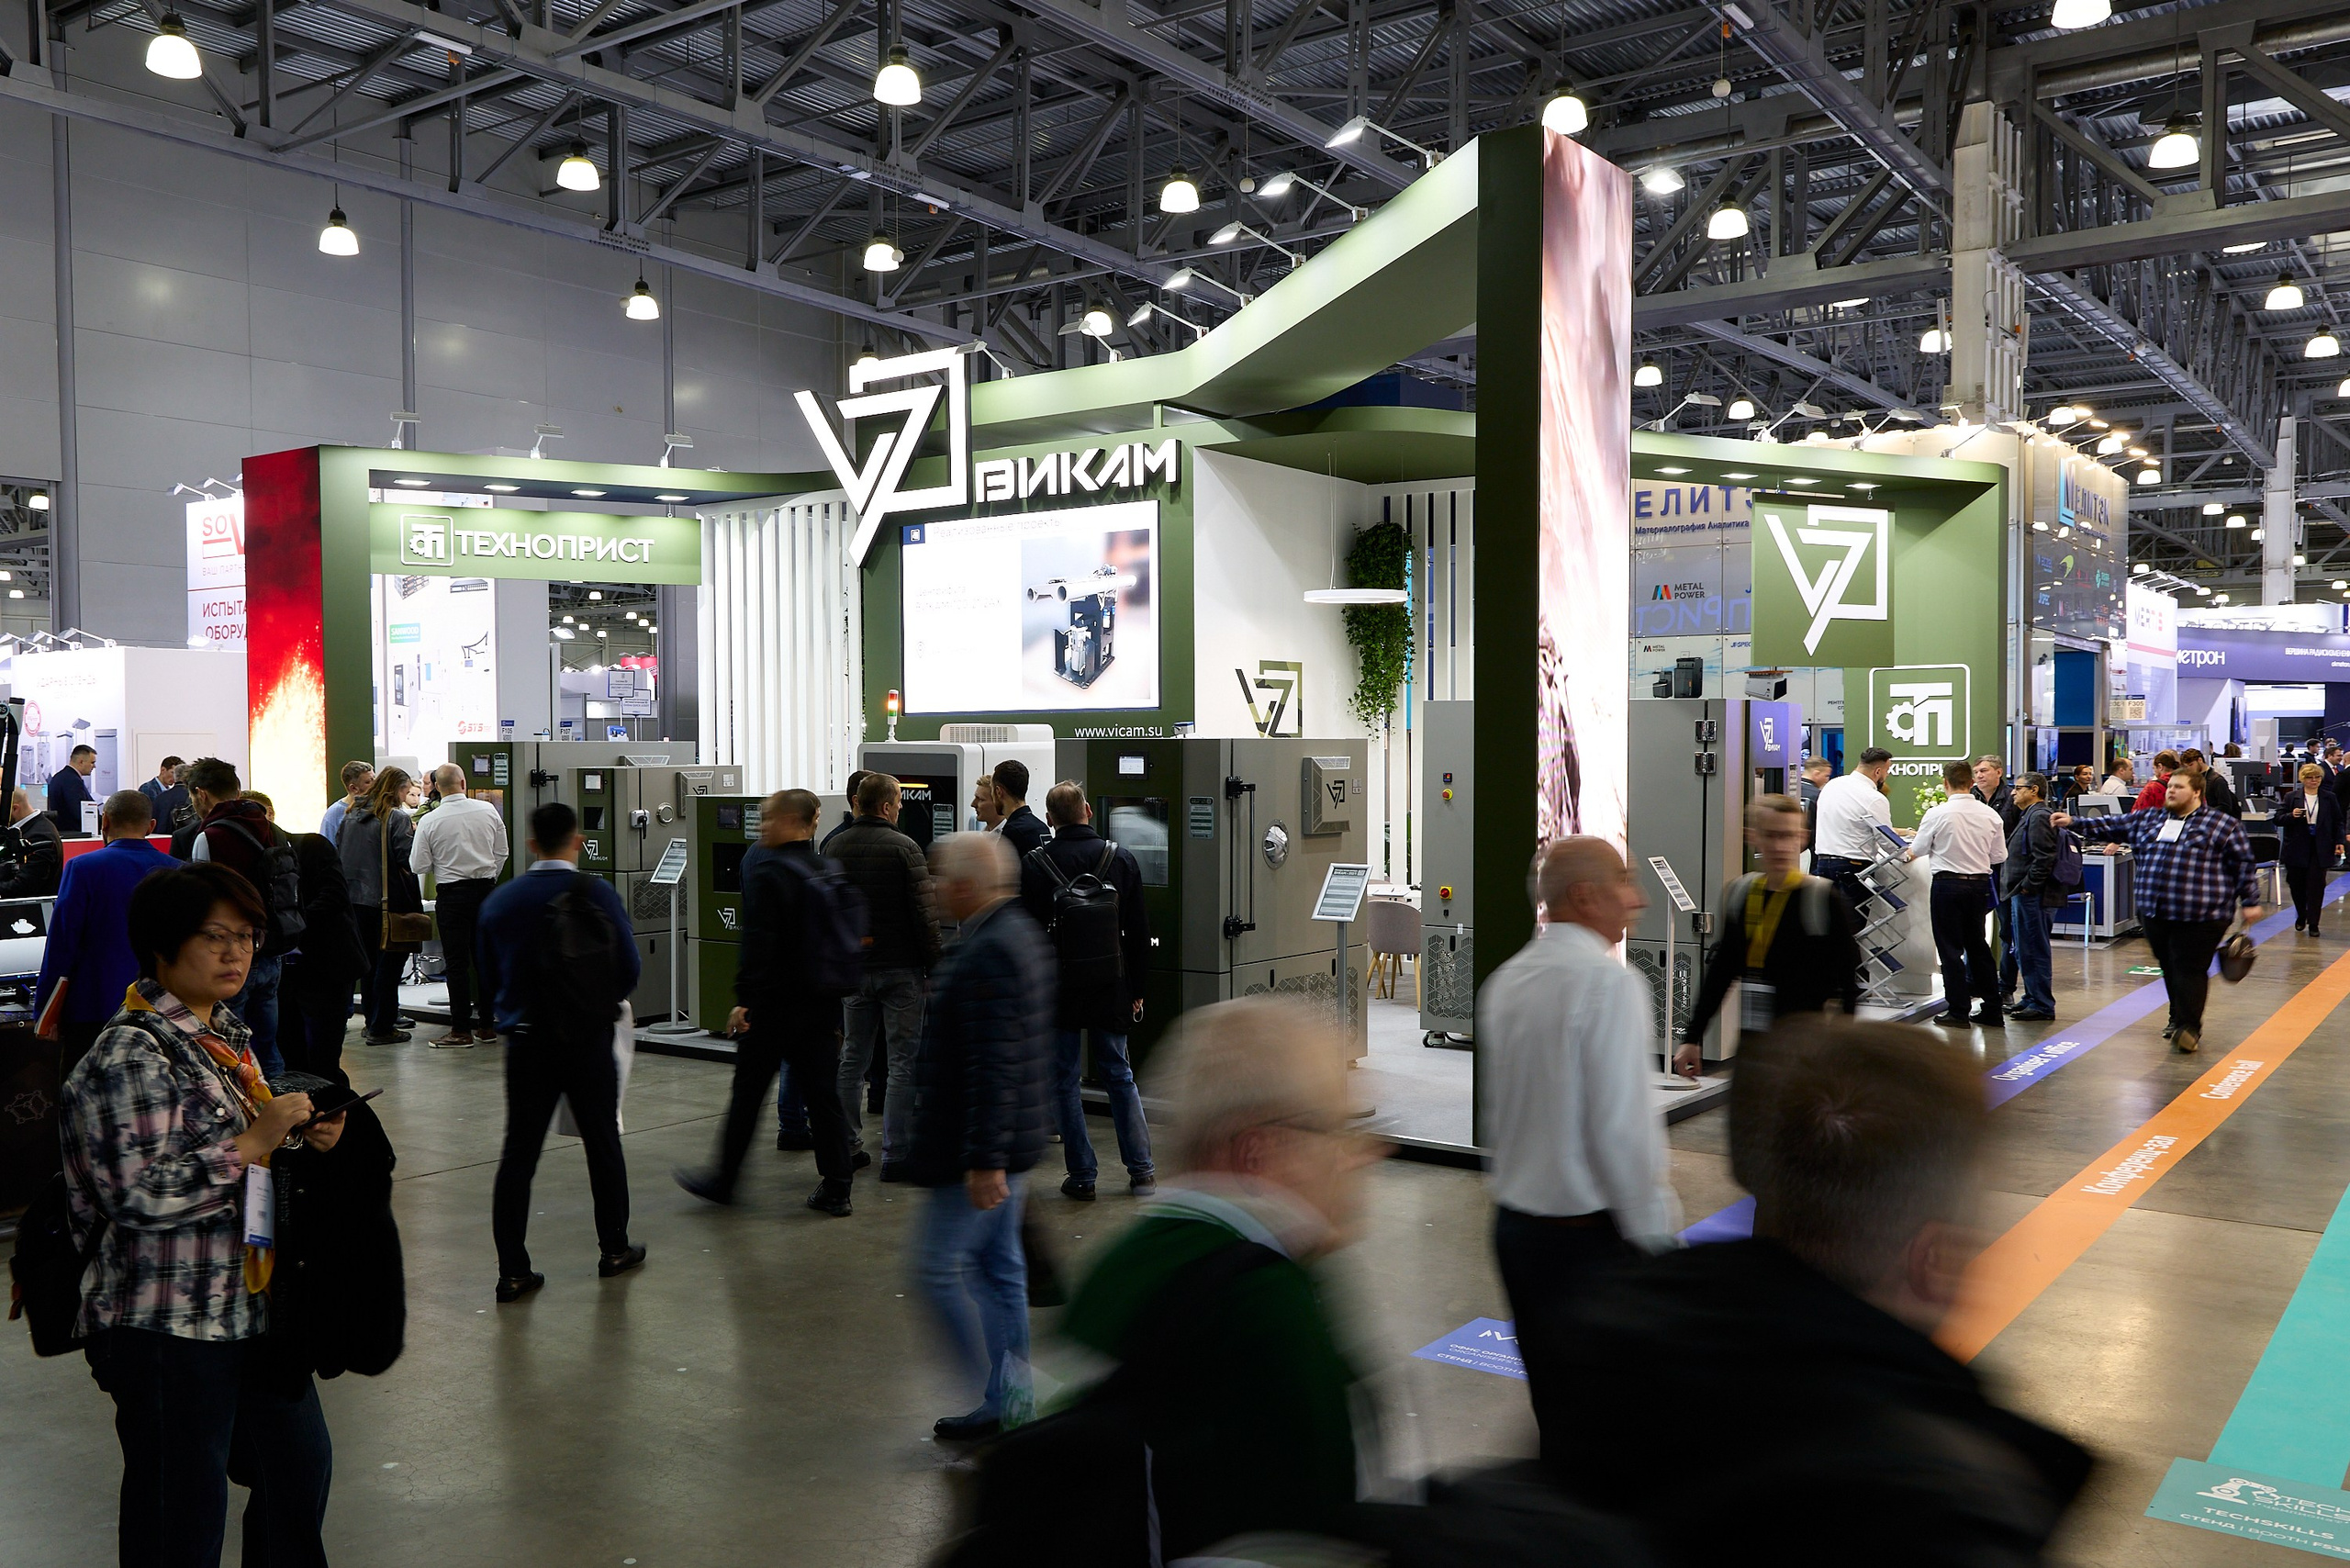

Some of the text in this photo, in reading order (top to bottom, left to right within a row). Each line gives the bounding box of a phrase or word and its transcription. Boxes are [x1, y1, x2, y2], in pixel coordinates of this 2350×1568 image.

[975, 438, 1179, 503] ВИКАМ
[1636, 520, 1750, 534] Материалография Аналитика
[455, 529, 655, 563] ТЕХНОПРИСТ
[1674, 582, 1704, 590] METAL
[1674, 591, 1705, 599] POWER
[1074, 724, 1163, 737] www.vicam.su
[2042, 1041, 2081, 1055] office
[2199, 1058, 2266, 1100] Conference hall
[2080, 1135, 2179, 1195] Конференц-зал
[1449, 1343, 1481, 1353] ОФИС
[1437, 1352, 1473, 1364] СТЕНД
[1479, 1361, 1516, 1373] BOOTH
[2180, 1513, 2235, 1529] СТЕНД
[2248, 1528, 2308, 1544] BOOTH
[2204, 1506, 2334, 1540] TECHSKILLS
